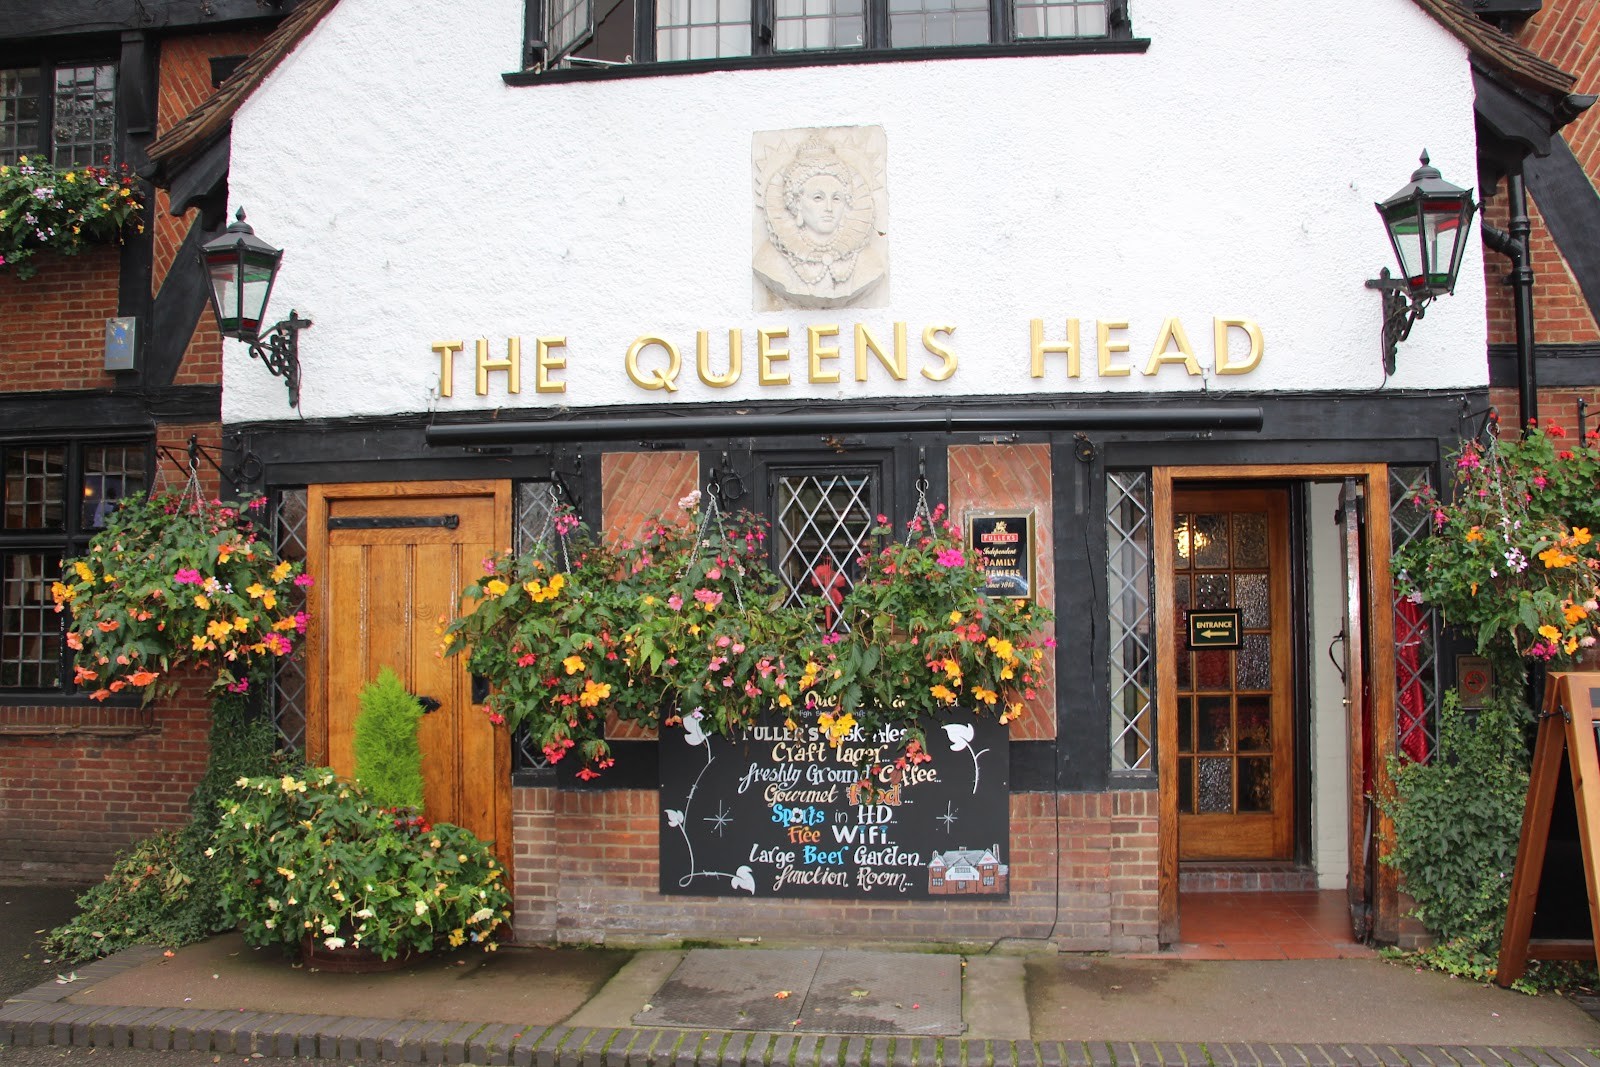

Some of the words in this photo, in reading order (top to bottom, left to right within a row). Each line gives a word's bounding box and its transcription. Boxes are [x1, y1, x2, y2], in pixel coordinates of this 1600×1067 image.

[431, 336, 567, 398] THE
[624, 321, 958, 394] QUEENS
[1029, 316, 1265, 378] HEAD
[983, 547, 1016, 557] Independent
[984, 559, 1016, 567] FAMILY
[1197, 621, 1232, 629] ENTRANCE
[771, 742, 827, 763] Craft
[879, 763, 942, 787] Cffee...
[764, 783, 839, 808] Gourmet
[771, 803, 825, 828] Sports
[834, 809, 849, 824] in
[787, 824, 821, 844] Free
[748, 843, 795, 869] Large
[802, 845, 849, 865] Beer
